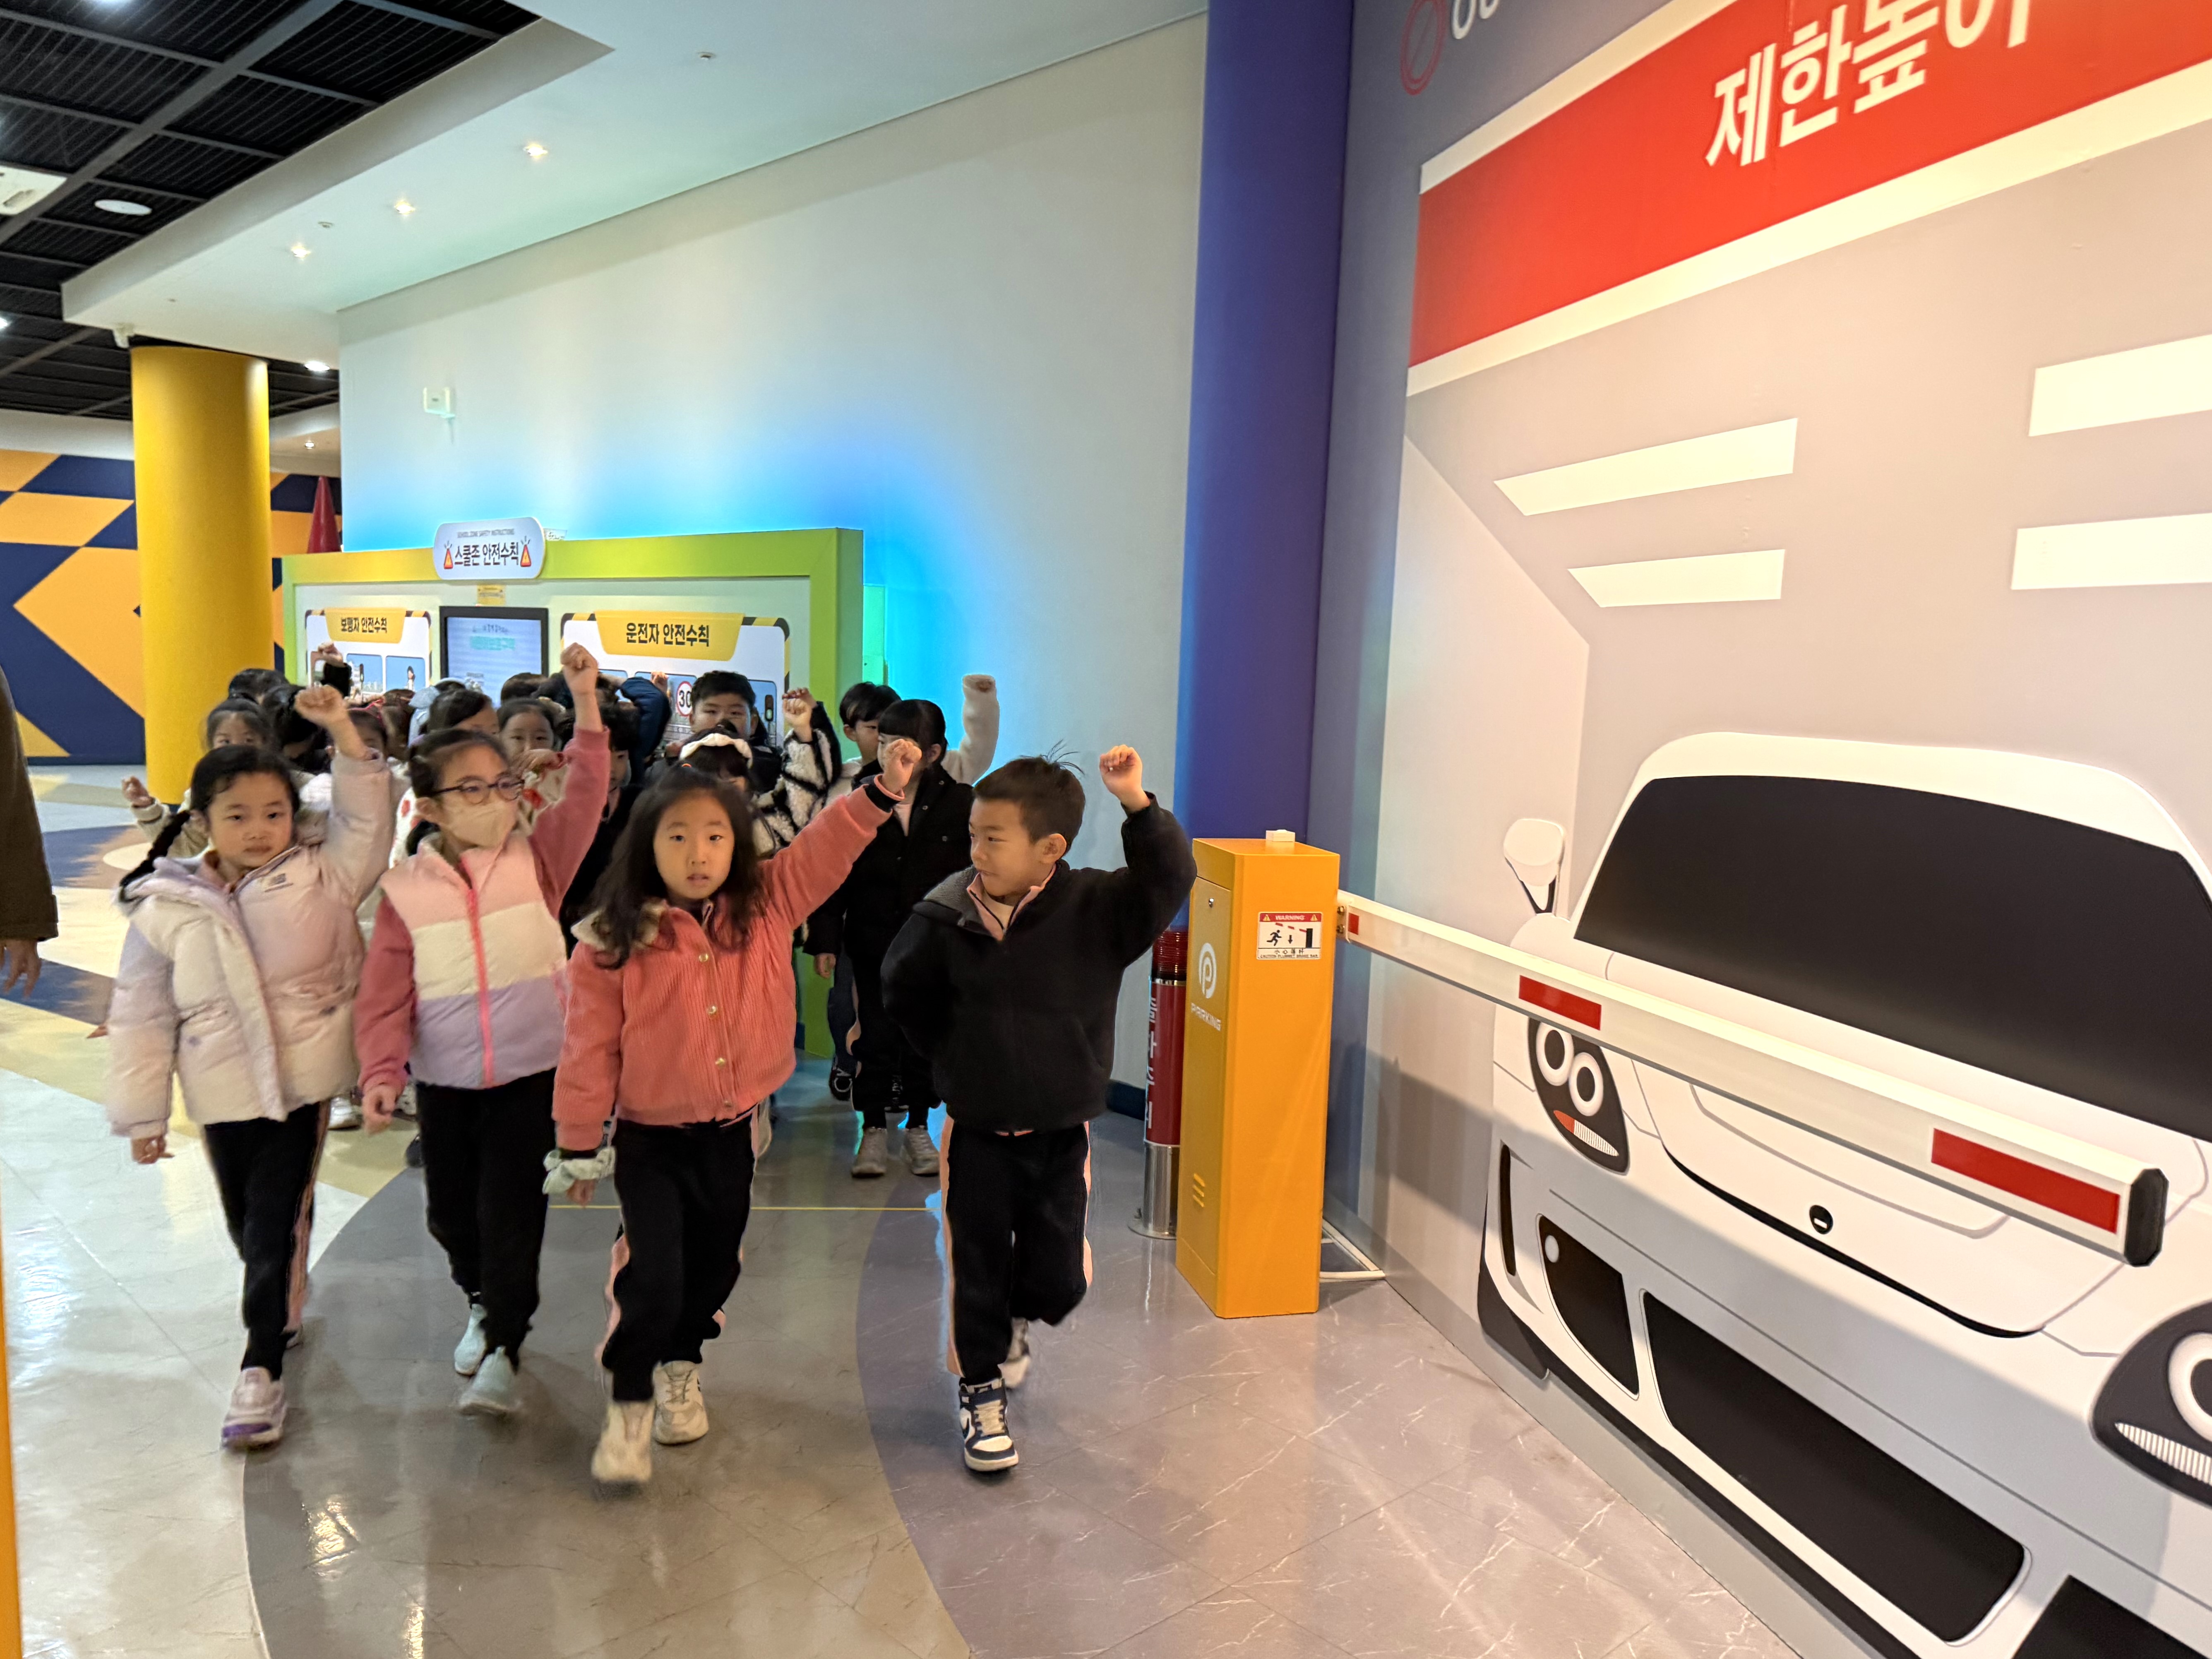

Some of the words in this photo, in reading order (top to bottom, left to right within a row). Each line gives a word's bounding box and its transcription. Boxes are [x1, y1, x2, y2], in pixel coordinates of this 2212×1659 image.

[454, 544, 480, 566] 스쿨존
[482, 542, 519, 566] 안전수칙
[361, 617, 387, 633] 안전수칙
[626, 623, 660, 644] 운전자
[663, 624, 709, 647] 안전수칙
[679, 690, 692, 708] 30
